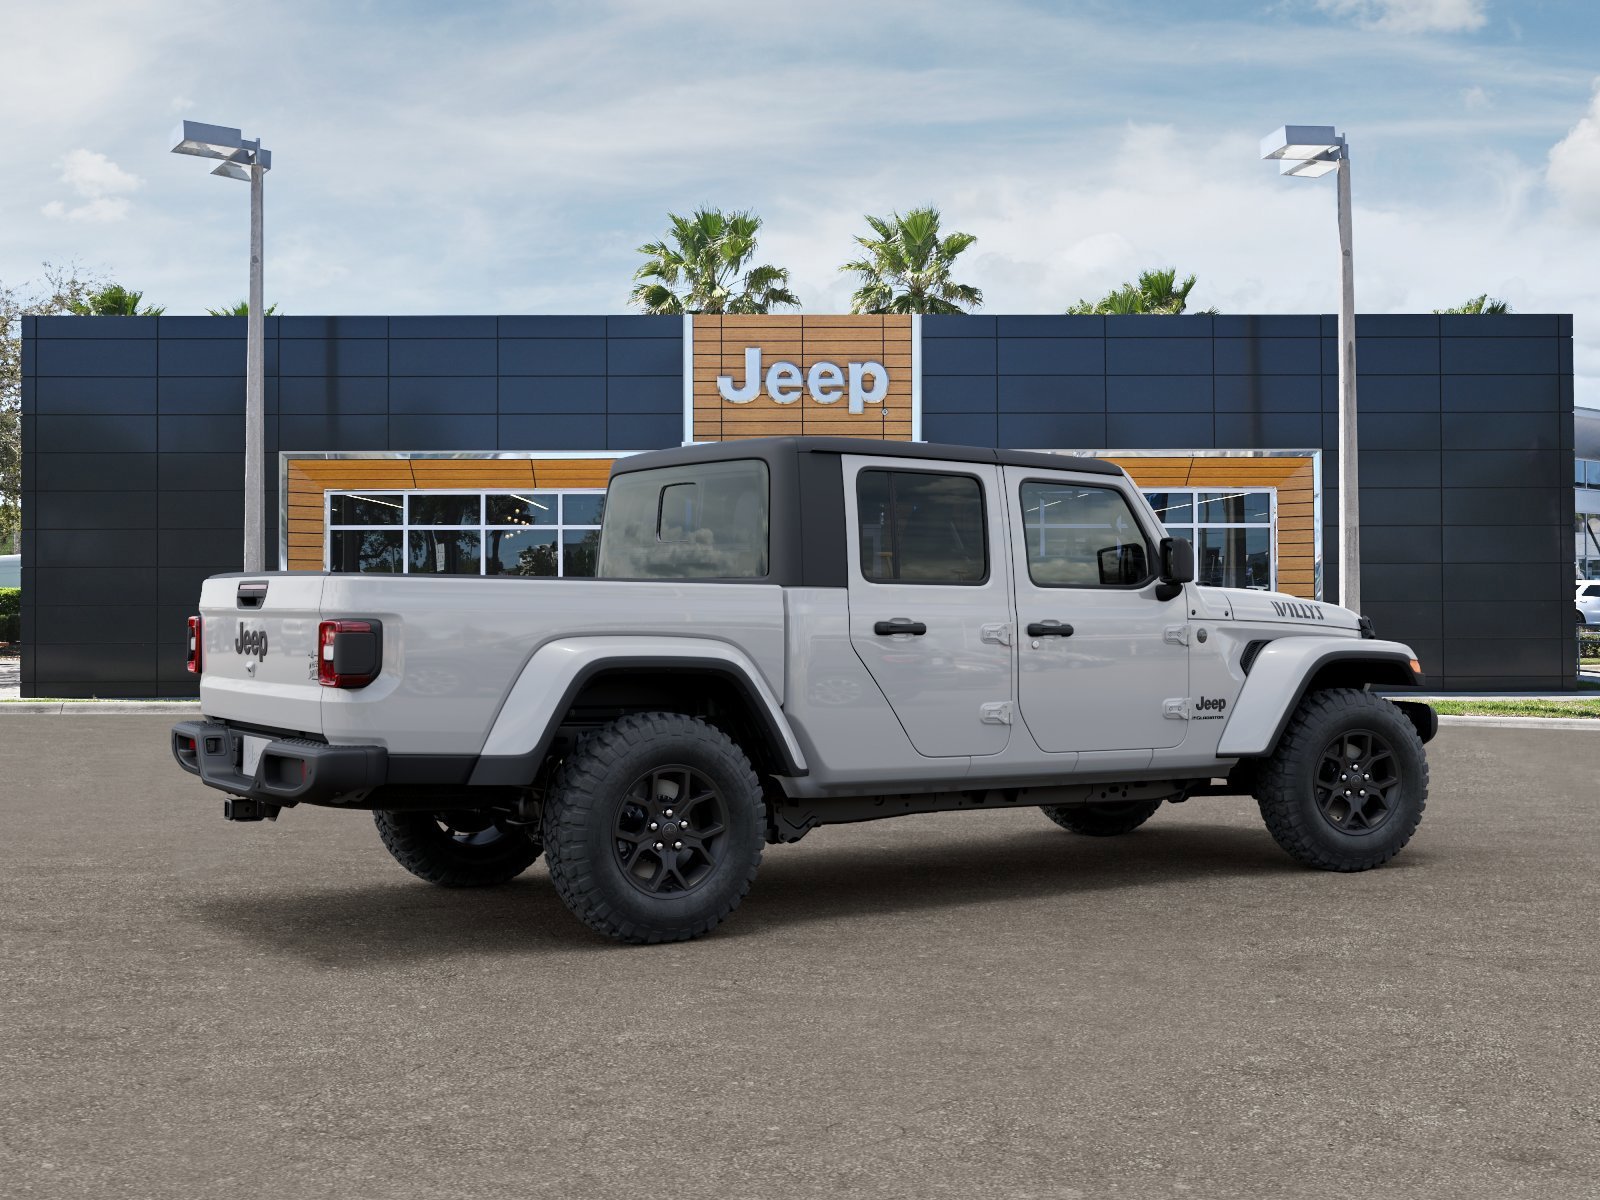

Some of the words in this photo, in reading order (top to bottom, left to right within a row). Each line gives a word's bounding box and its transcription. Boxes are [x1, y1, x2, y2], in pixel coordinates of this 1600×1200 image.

[716, 347, 890, 415] Jeep
[1270, 600, 1325, 620] WILLYS
[235, 621, 268, 663] Jeep
[1195, 696, 1227, 712] Jeep
